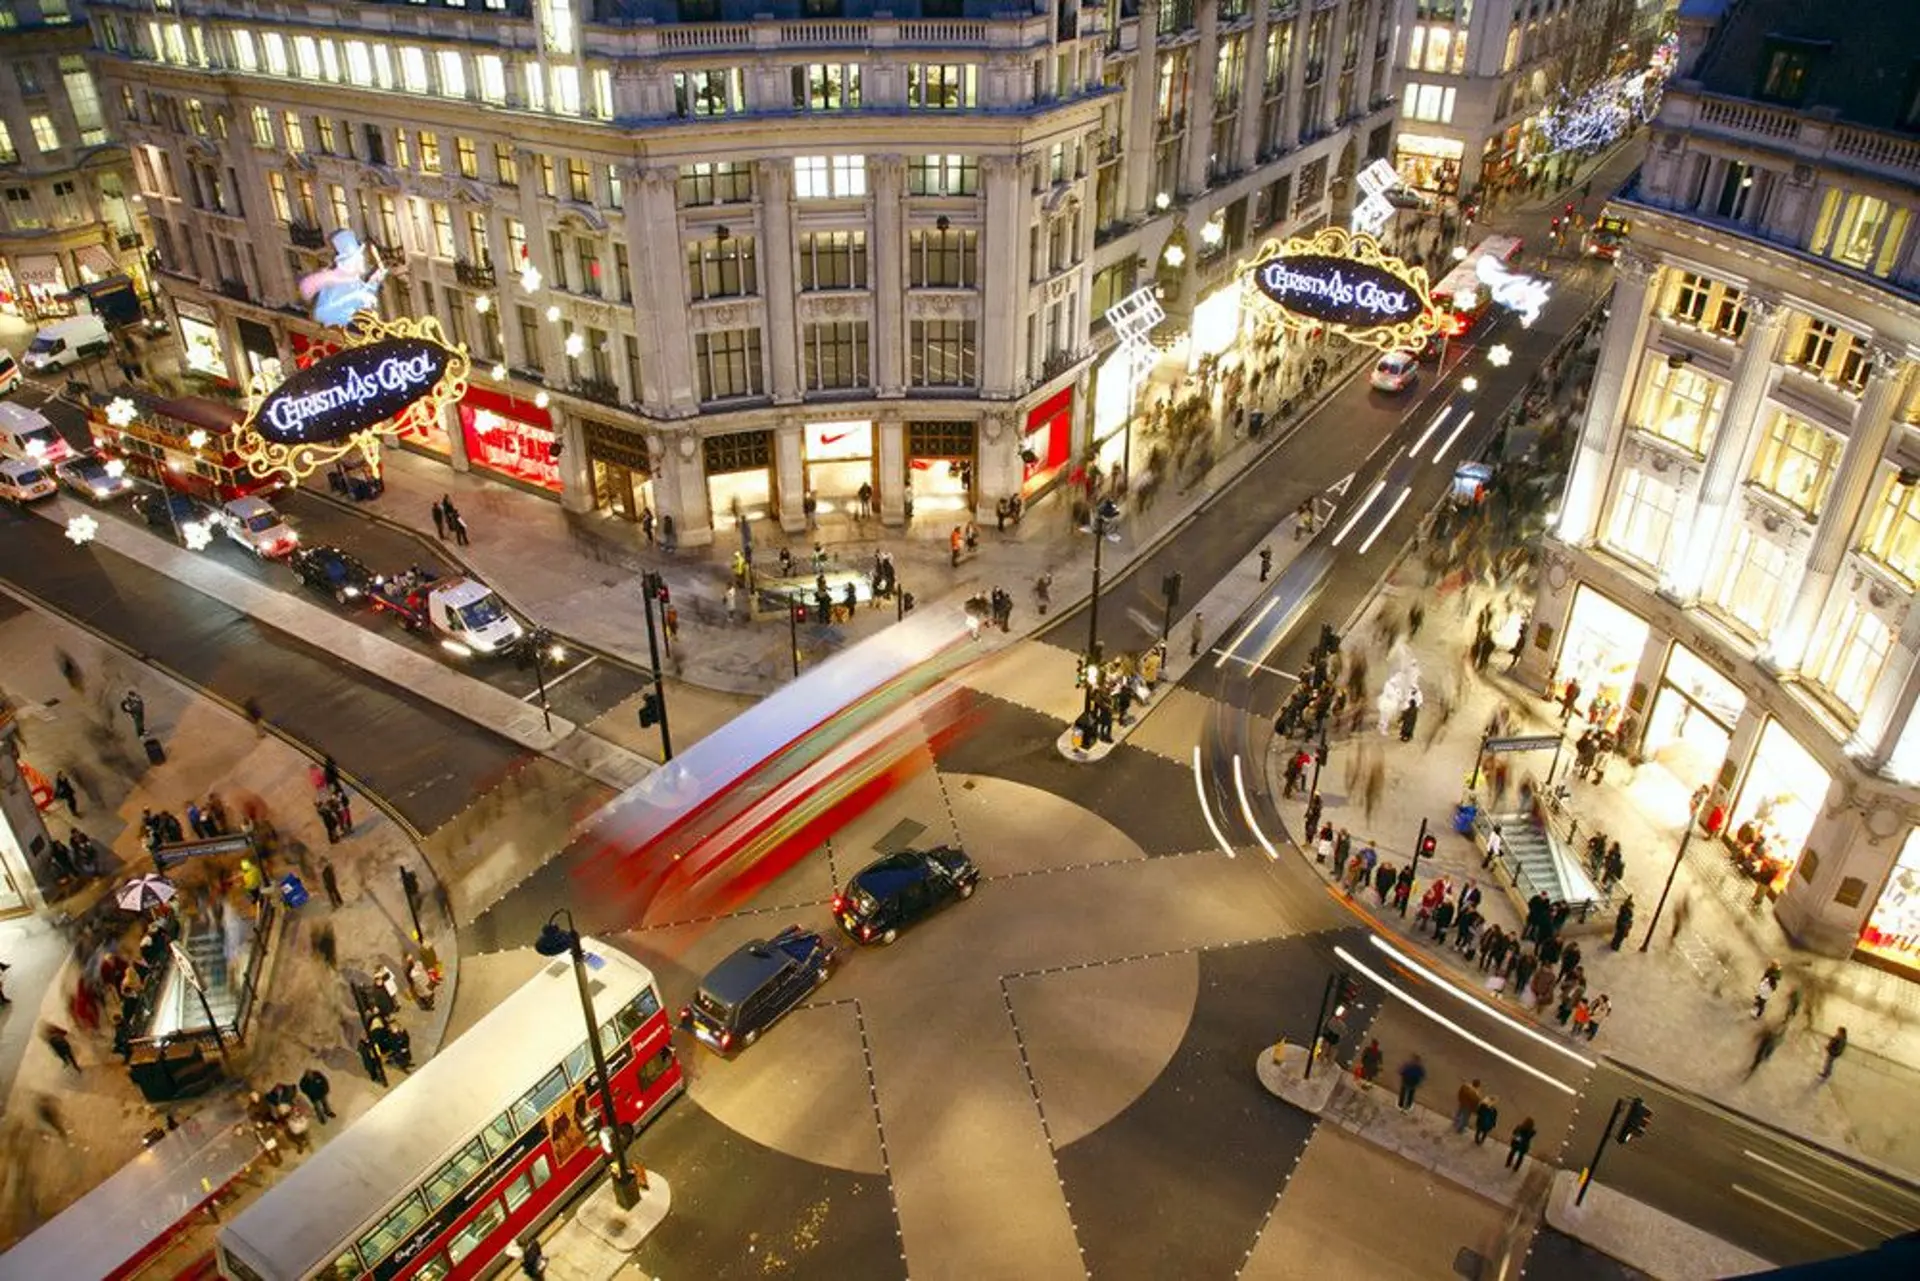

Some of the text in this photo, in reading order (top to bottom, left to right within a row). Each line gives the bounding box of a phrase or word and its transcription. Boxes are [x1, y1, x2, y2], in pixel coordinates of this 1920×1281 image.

[1264, 263, 1410, 314] CHRISTMAS CAROL
[267, 350, 437, 431] CHRISTMAS CAROL
